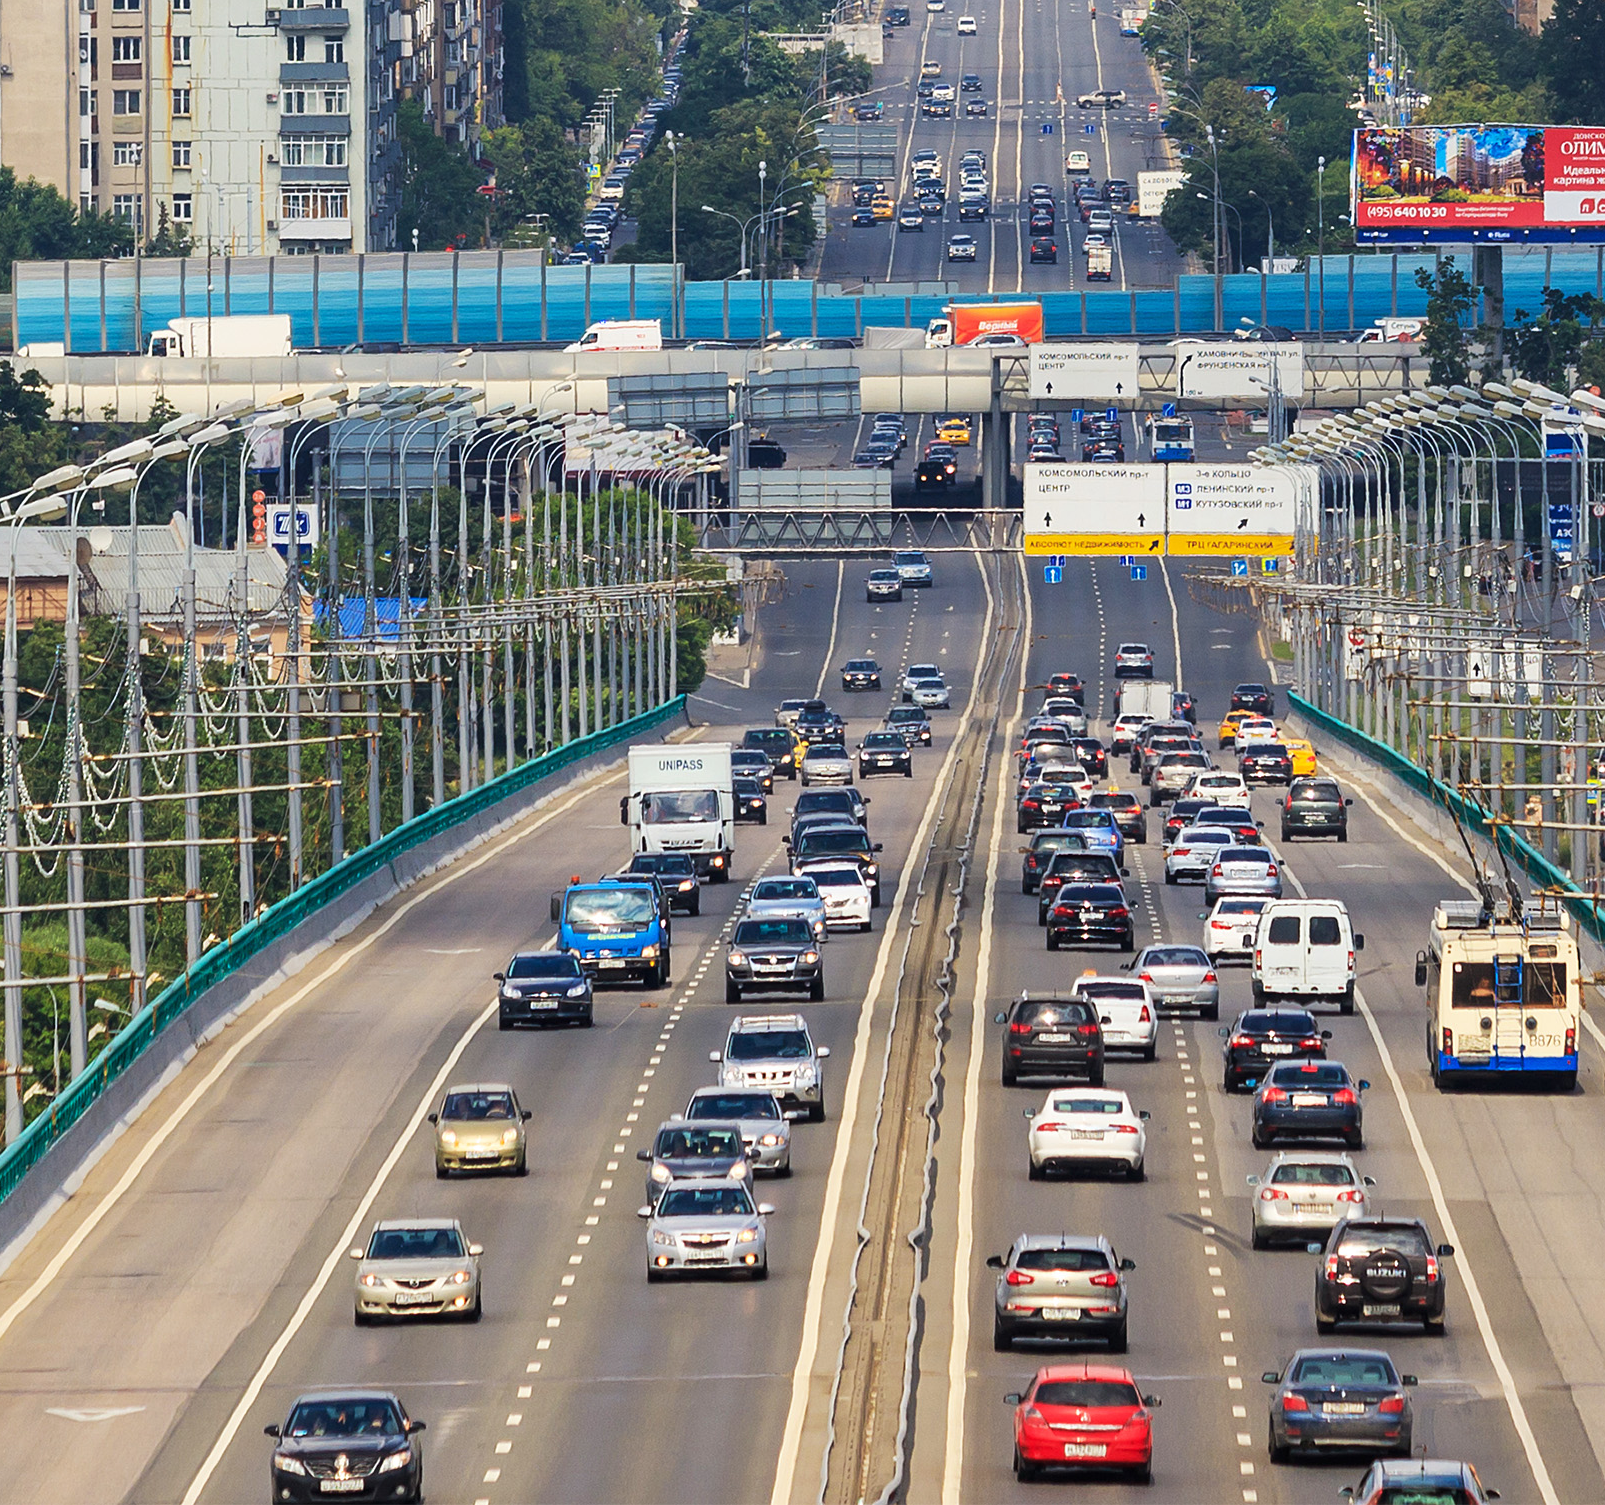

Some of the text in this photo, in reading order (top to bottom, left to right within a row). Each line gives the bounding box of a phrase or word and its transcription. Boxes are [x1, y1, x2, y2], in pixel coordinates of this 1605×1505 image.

[1553, 177, 1595, 187] картина
[1367, 206, 1393, 218] (495)
[1394, 206, 1417, 218] 640
[1417, 206, 1431, 218] 10
[1431, 206, 1447, 218] 30
[1038, 352, 1129, 362] КОМСОМОЛЬСКИЙ пр-т
[1038, 362, 1066, 371] ЦЕНТР
[1196, 361, 1256, 369] ФРУНЗЕНСКАЯ
[1038, 469, 1149, 479] КОМСОМОЛЬСКИЙ пр-т
[1195, 469, 1252, 479] 3-е КОЛЬЦО
[1038, 484, 1071, 493] ЦЕНТР
[1196, 484, 1275, 494] ЛЕНИНСКИЙ пр-т
[1195, 499, 1283, 509] КУТУЗОВСКИЙ пр-т
[1074, 541, 1145, 549] НЕДВИЖИМОСТЬ
[1186, 540, 1274, 550] ТРЦ ГАГАРИНСКИЙ
[658, 759, 703, 771] UNIPASS
[1529, 1034, 1561, 1047] 8876
[1366, 1268, 1406, 1278] SUZUKI
